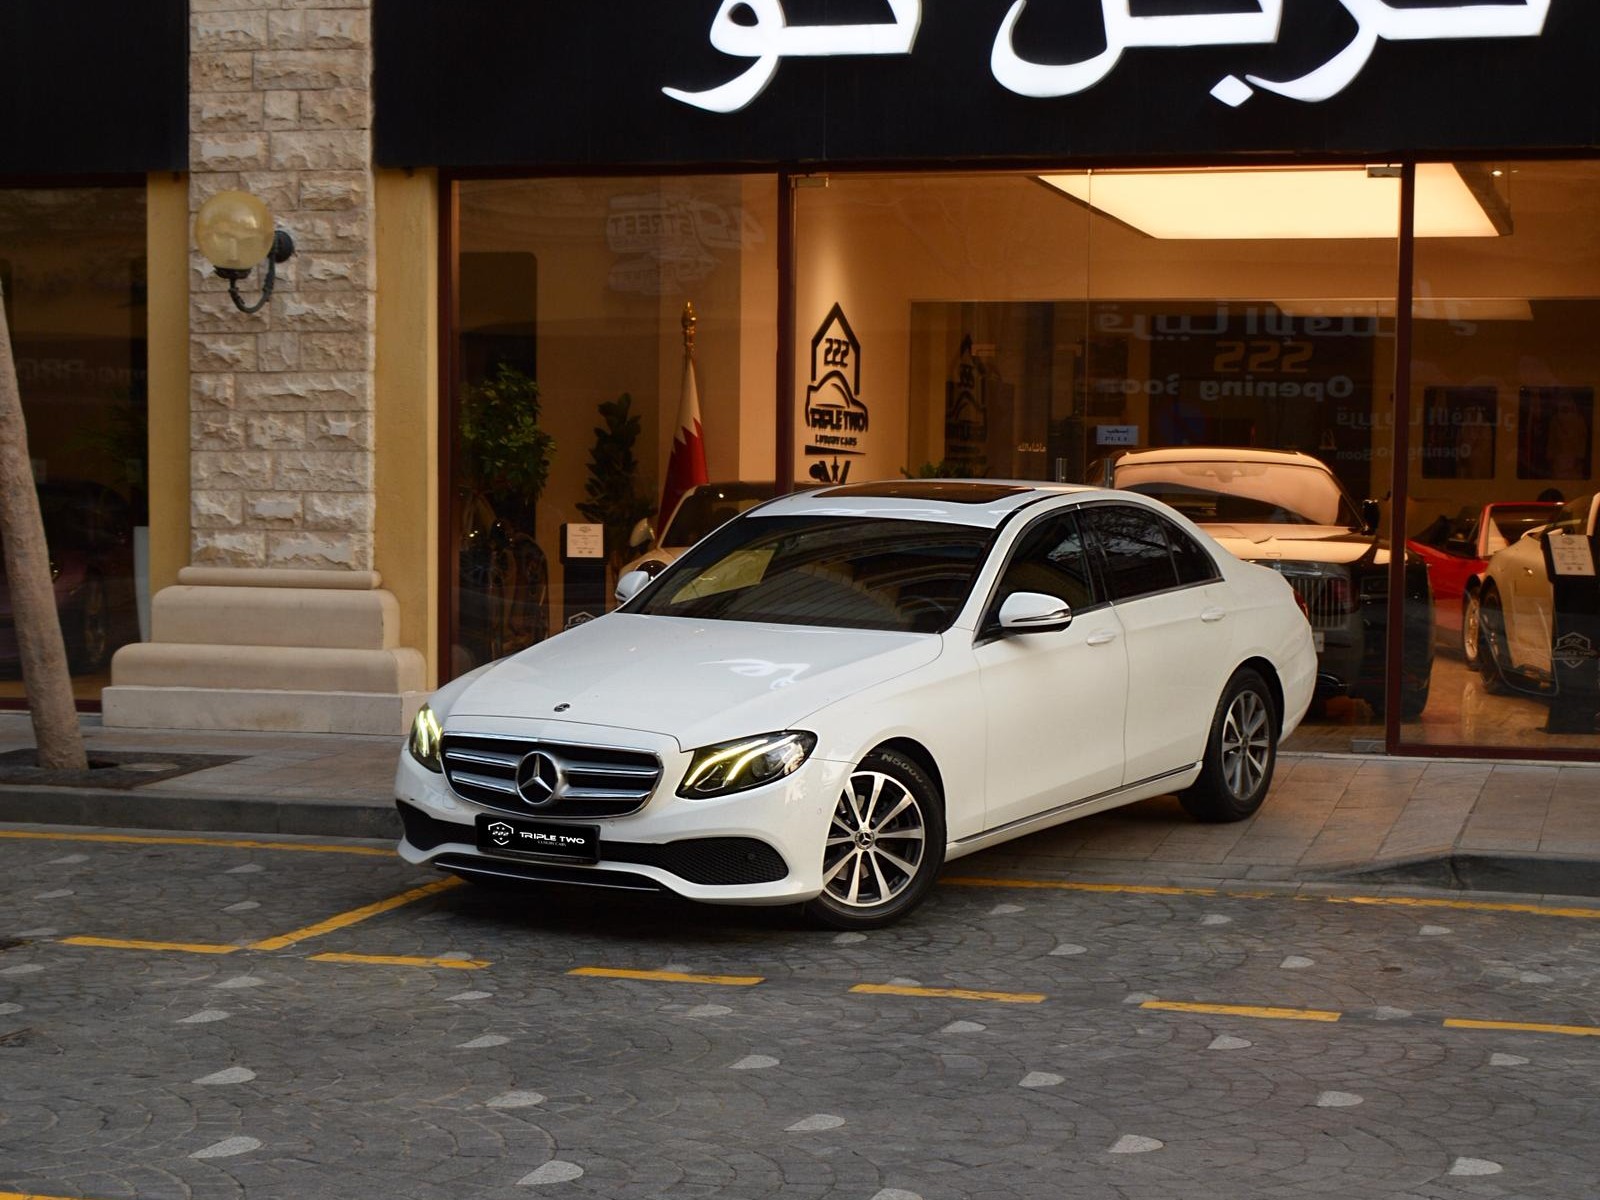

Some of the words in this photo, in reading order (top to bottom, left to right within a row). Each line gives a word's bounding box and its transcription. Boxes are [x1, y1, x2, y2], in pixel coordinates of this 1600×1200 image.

[824, 338, 849, 367] 222
[519, 831, 557, 842] TRIPLE
[559, 835, 585, 844] TWO
